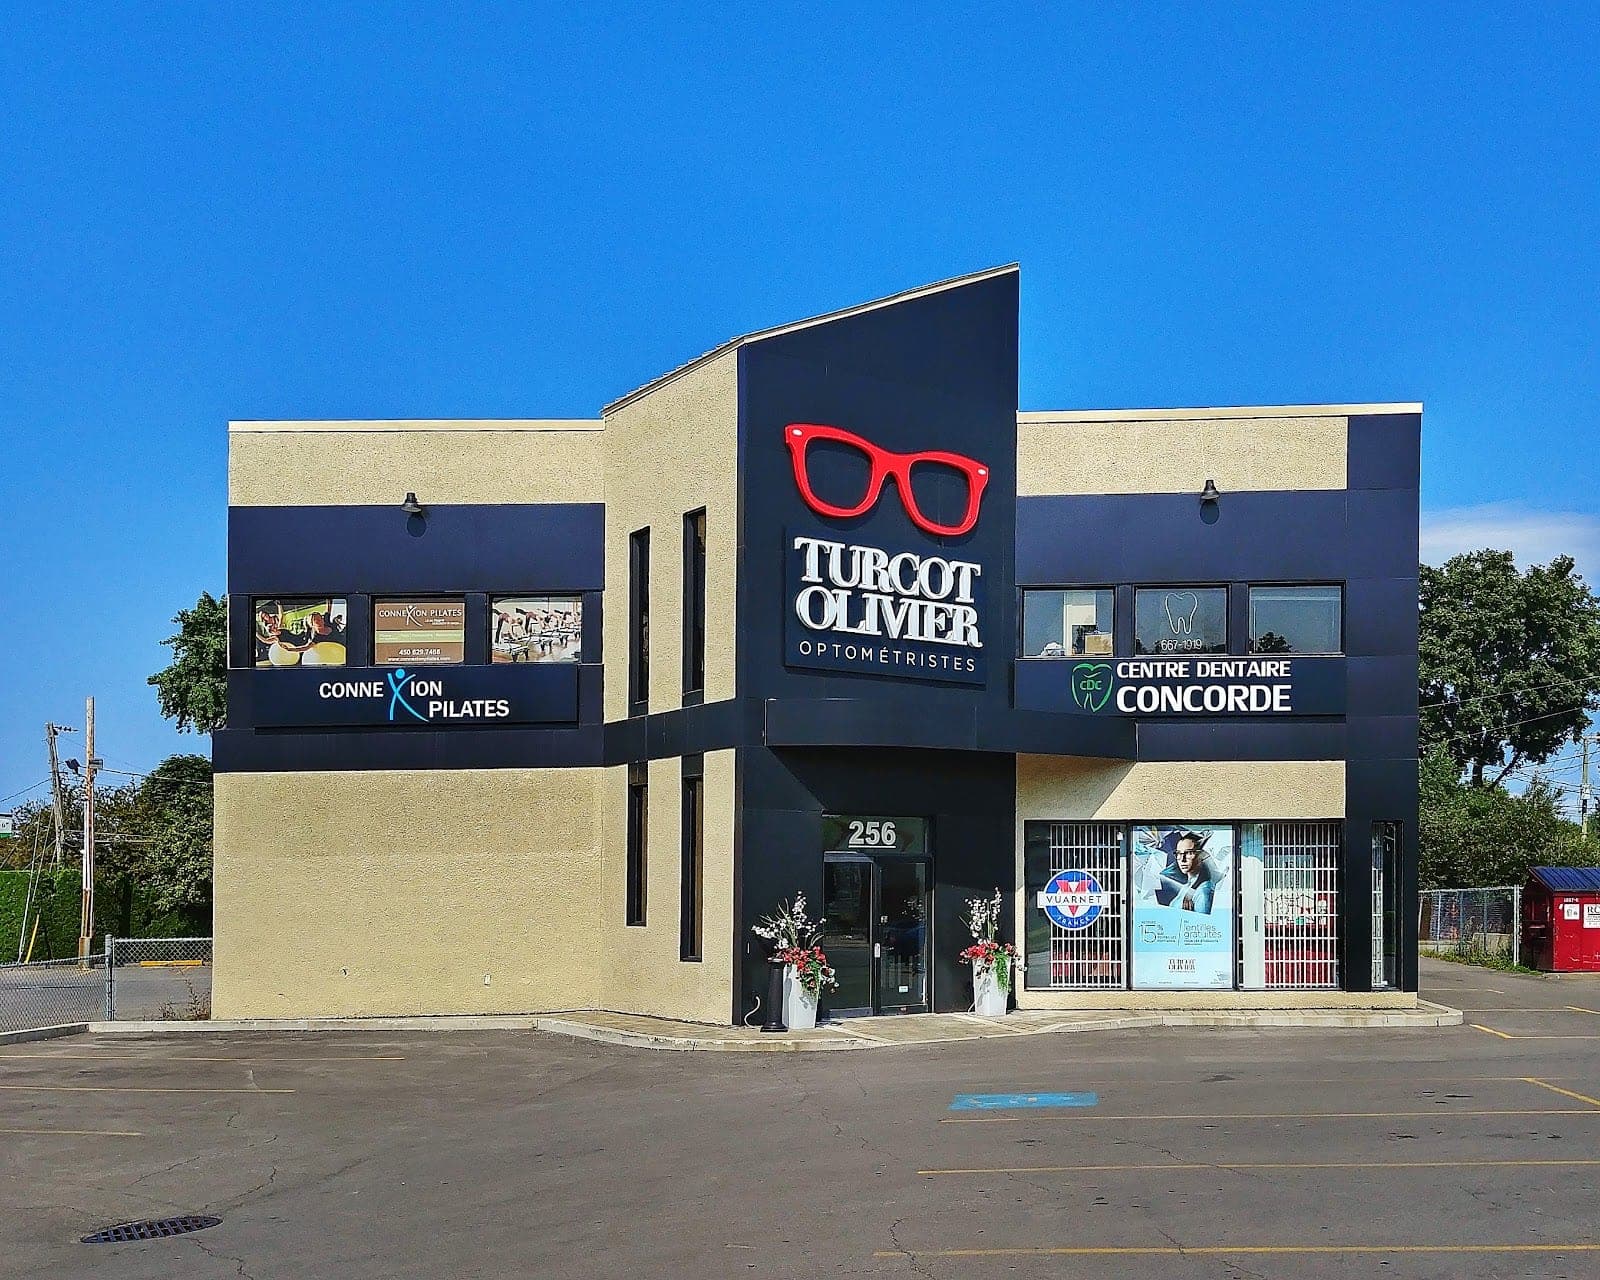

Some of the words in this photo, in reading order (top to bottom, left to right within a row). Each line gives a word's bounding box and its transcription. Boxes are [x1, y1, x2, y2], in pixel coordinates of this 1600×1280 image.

[794, 537, 981, 603] TURCOT
[430, 609, 462, 617] PILATES
[796, 585, 983, 648] OLIVIER
[1160, 638, 1203, 652] 667-1919
[799, 641, 976, 673] OPTOMÉTRISTES
[1116, 661, 1190, 679] CENTRE
[1197, 661, 1292, 678] DENTAIRE
[1080, 680, 1102, 691] CDC
[1116, 685, 1292, 713] CONCORDE
[428, 699, 510, 719] PILATES
[849, 820, 897, 846] 256
[1046, 895, 1102, 904] VUARNET
[1056, 914, 1091, 926] FRANCE
